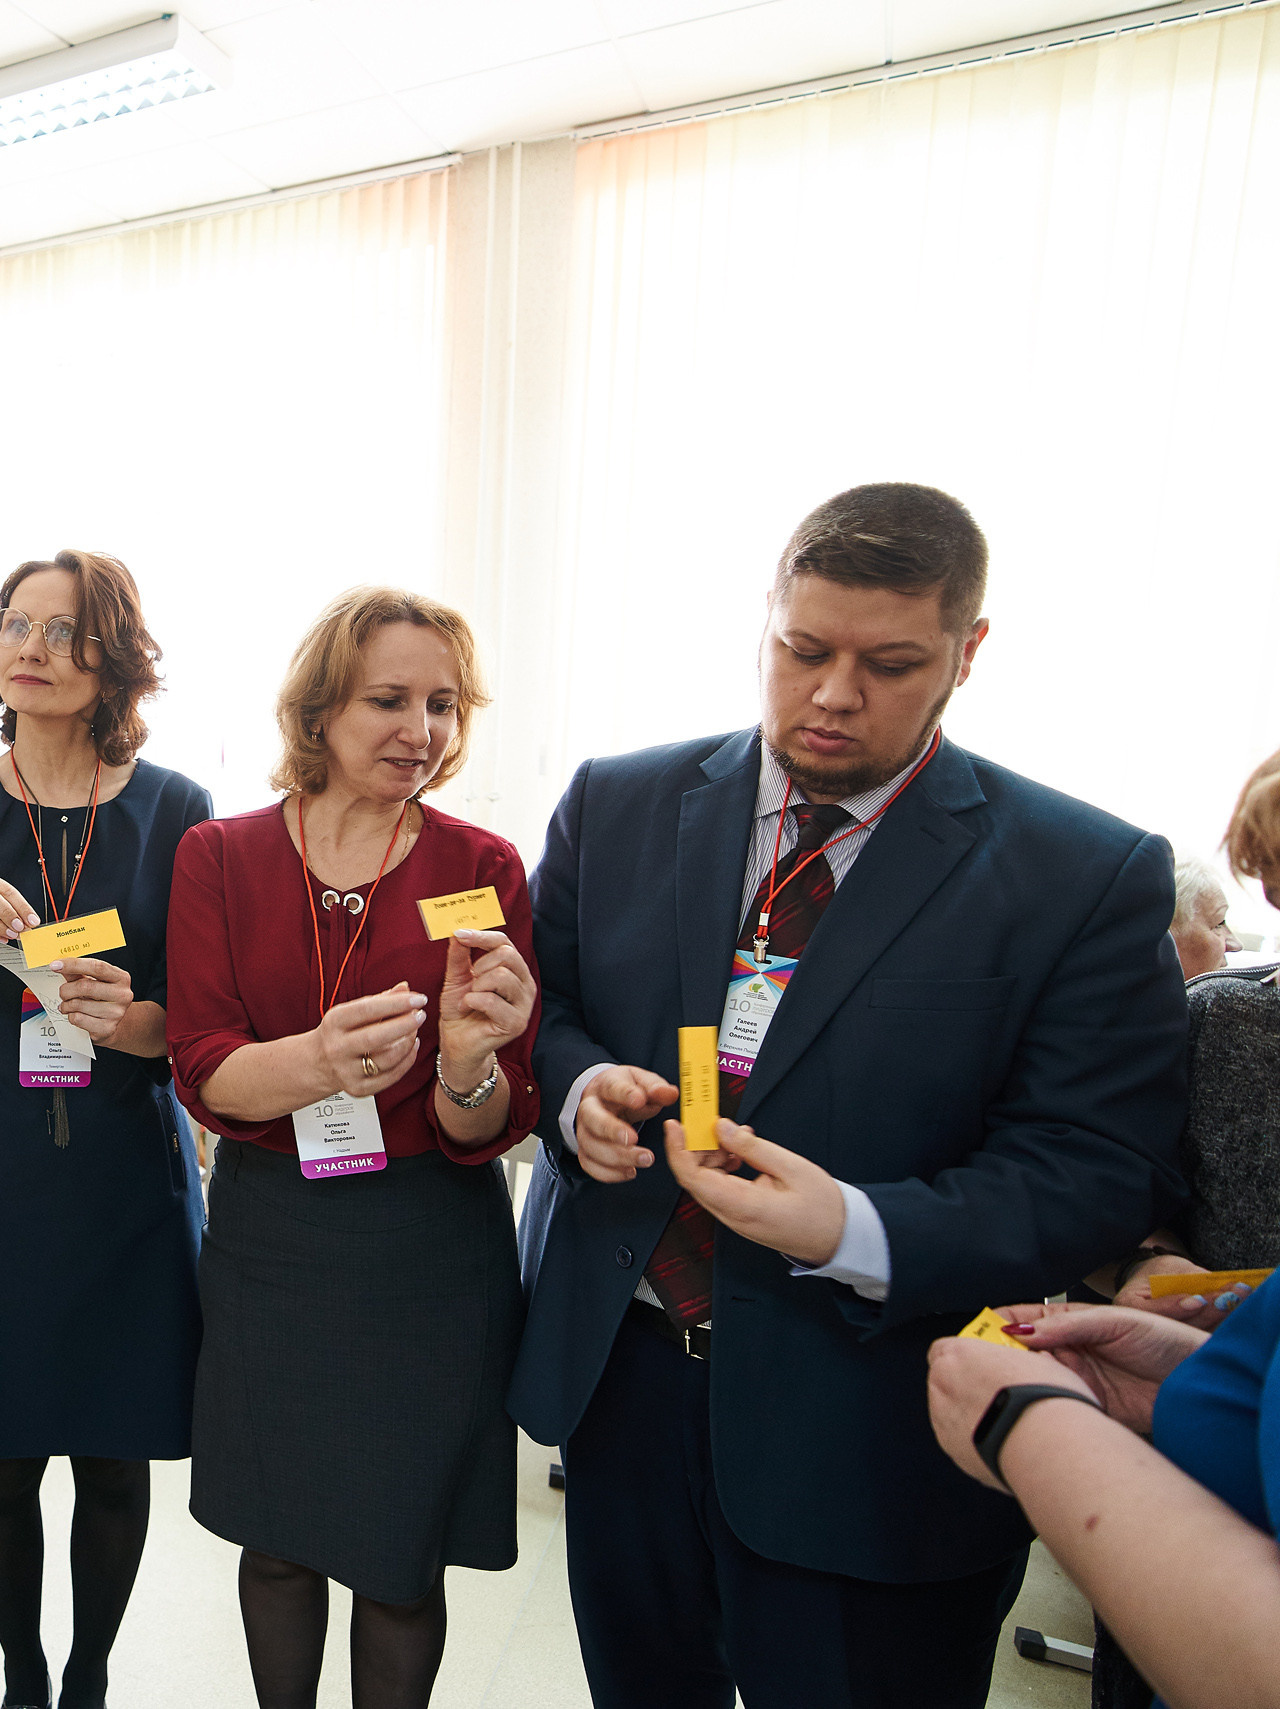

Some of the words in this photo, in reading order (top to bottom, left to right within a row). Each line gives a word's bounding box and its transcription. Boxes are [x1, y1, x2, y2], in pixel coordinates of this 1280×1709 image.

[56, 926, 86, 938] Монблан
[60, 944, 80, 955] (4810
[728, 999, 751, 1013] 10
[737, 1018, 757, 1027] Галеев
[40, 1026, 56, 1037] 10
[734, 1025, 757, 1035] Андрей
[728, 1032, 758, 1043] Олегович
[717, 1056, 753, 1072] АСТН
[30, 1075, 81, 1083] УЧАСТНИК
[314, 1104, 334, 1118] 10
[323, 1136, 356, 1144] Викторовна
[314, 1157, 375, 1173] УЧАСТНИК
